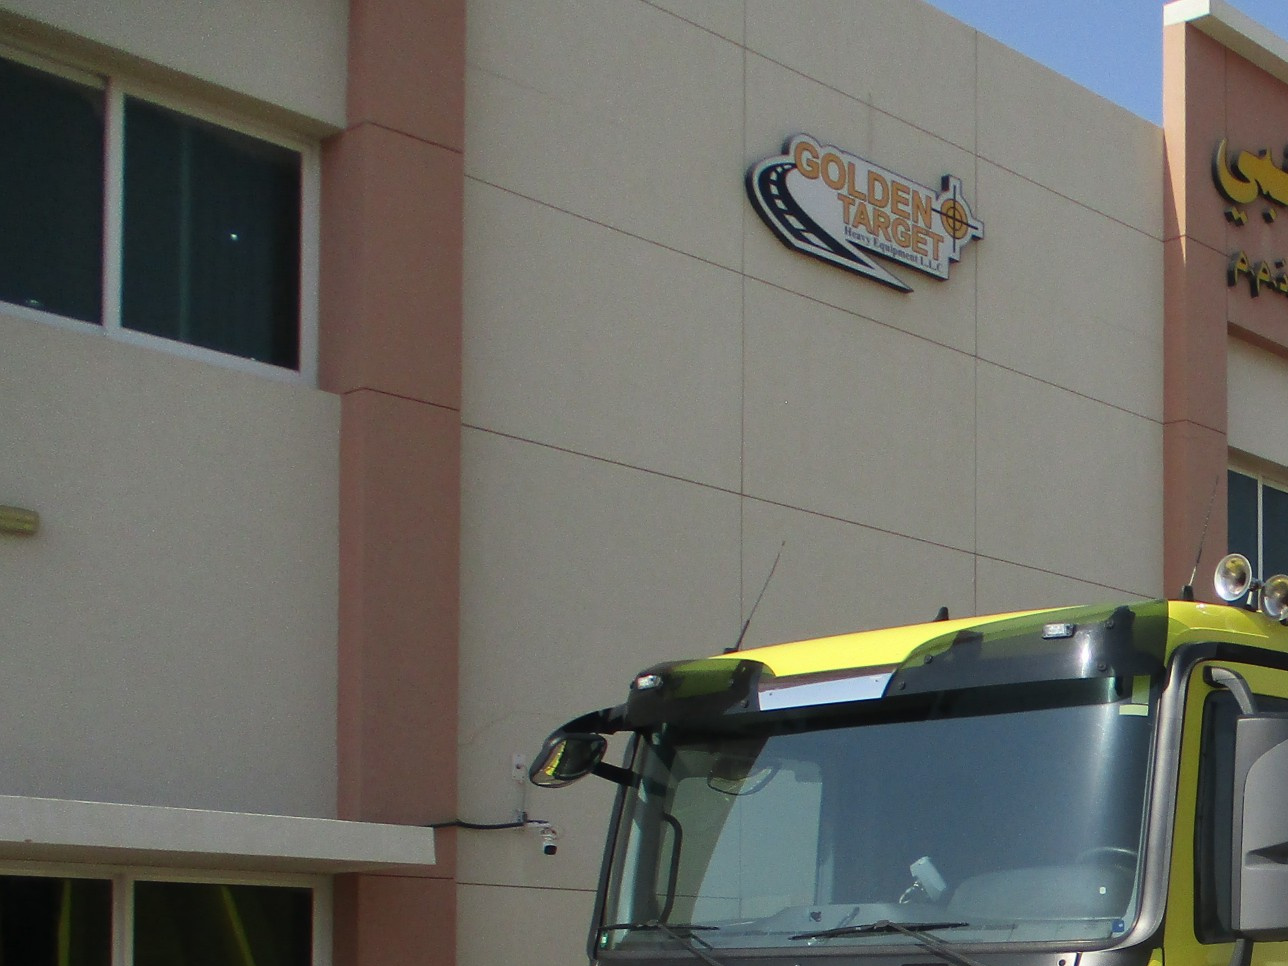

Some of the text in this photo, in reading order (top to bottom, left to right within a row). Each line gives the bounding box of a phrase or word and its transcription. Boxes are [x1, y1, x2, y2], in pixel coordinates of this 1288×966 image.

[794, 141, 933, 230] GOLDEN
[837, 192, 944, 261] TARGET
[844, 226, 871, 245] Heavy
[873, 235, 918, 263] Equipment
